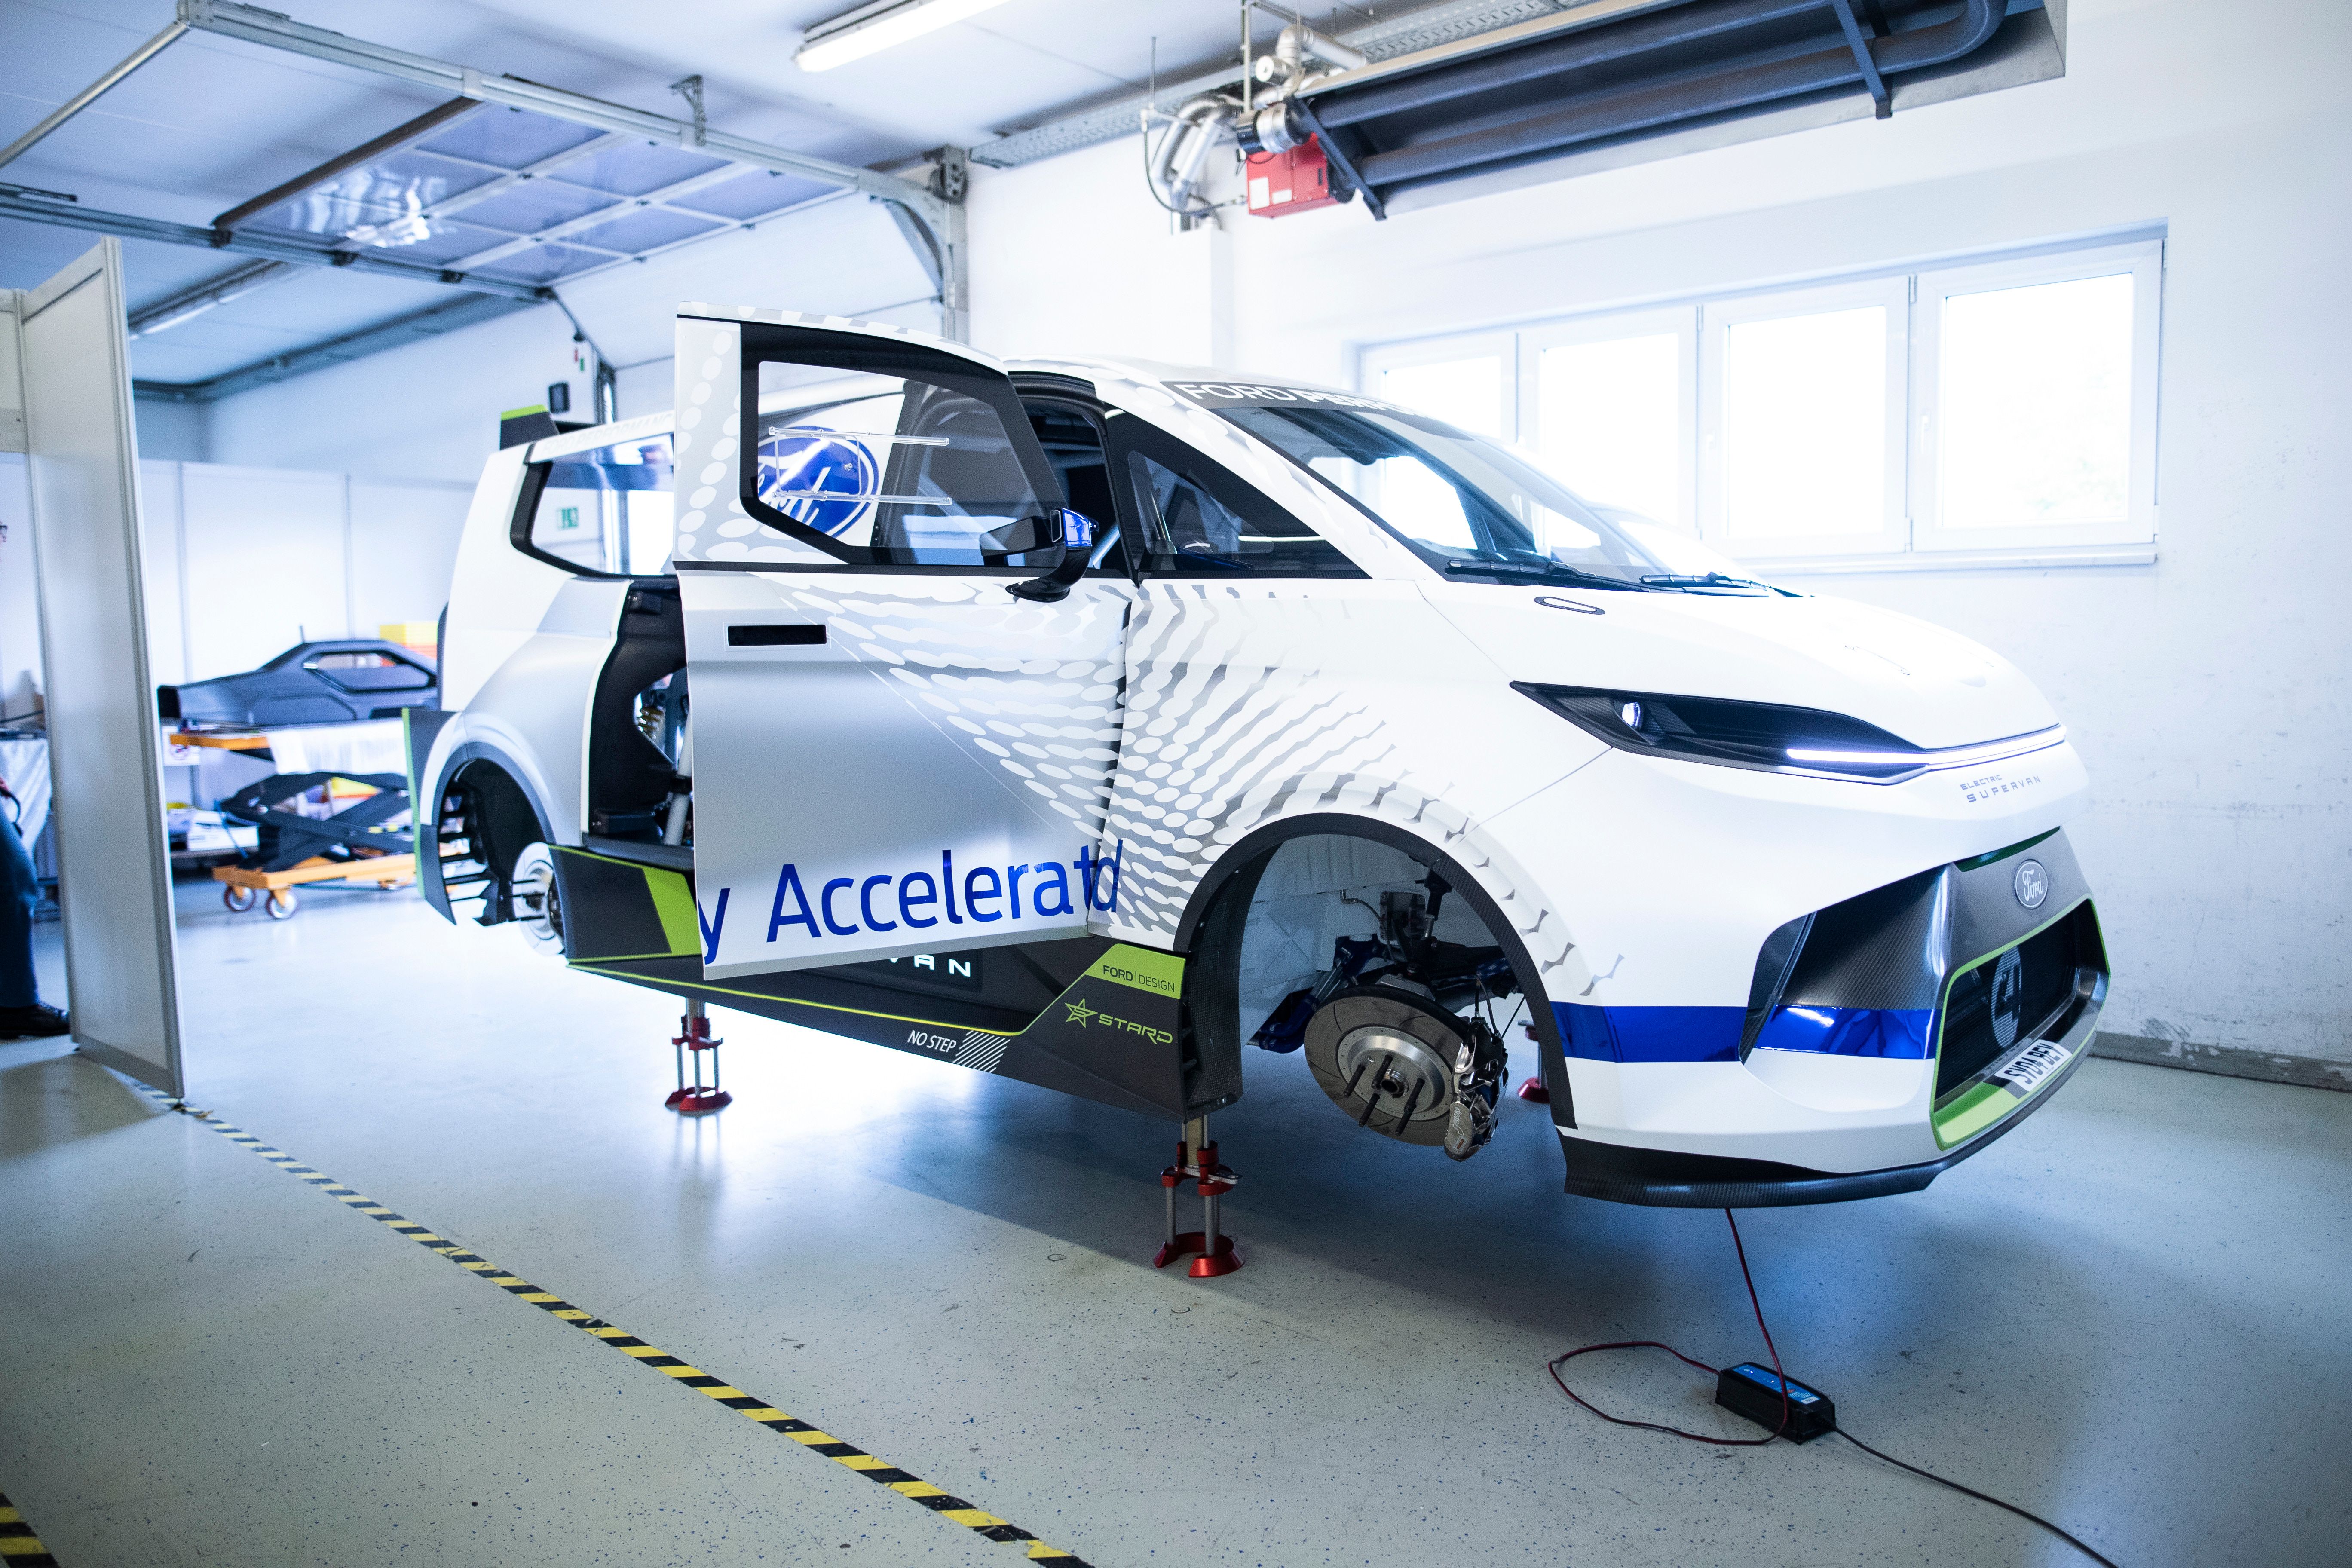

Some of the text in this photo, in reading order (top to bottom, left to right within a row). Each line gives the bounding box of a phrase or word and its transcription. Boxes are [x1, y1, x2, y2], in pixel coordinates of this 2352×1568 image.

[1174, 384, 1297, 401] FORD
[1960, 775, 2002, 790] ELECTRIC
[1966, 775, 2041, 802] SUPERVAN
[2022, 869, 2043, 901] Ford
[1103, 965, 1175, 992] FORD DESIGN
[1098, 1014, 1173, 1044] STARD
[907, 1030, 957, 1053] NO STEP
[2026, 1043, 2064, 1066] BEV
[1453, 1106, 1462, 1126] alcon
